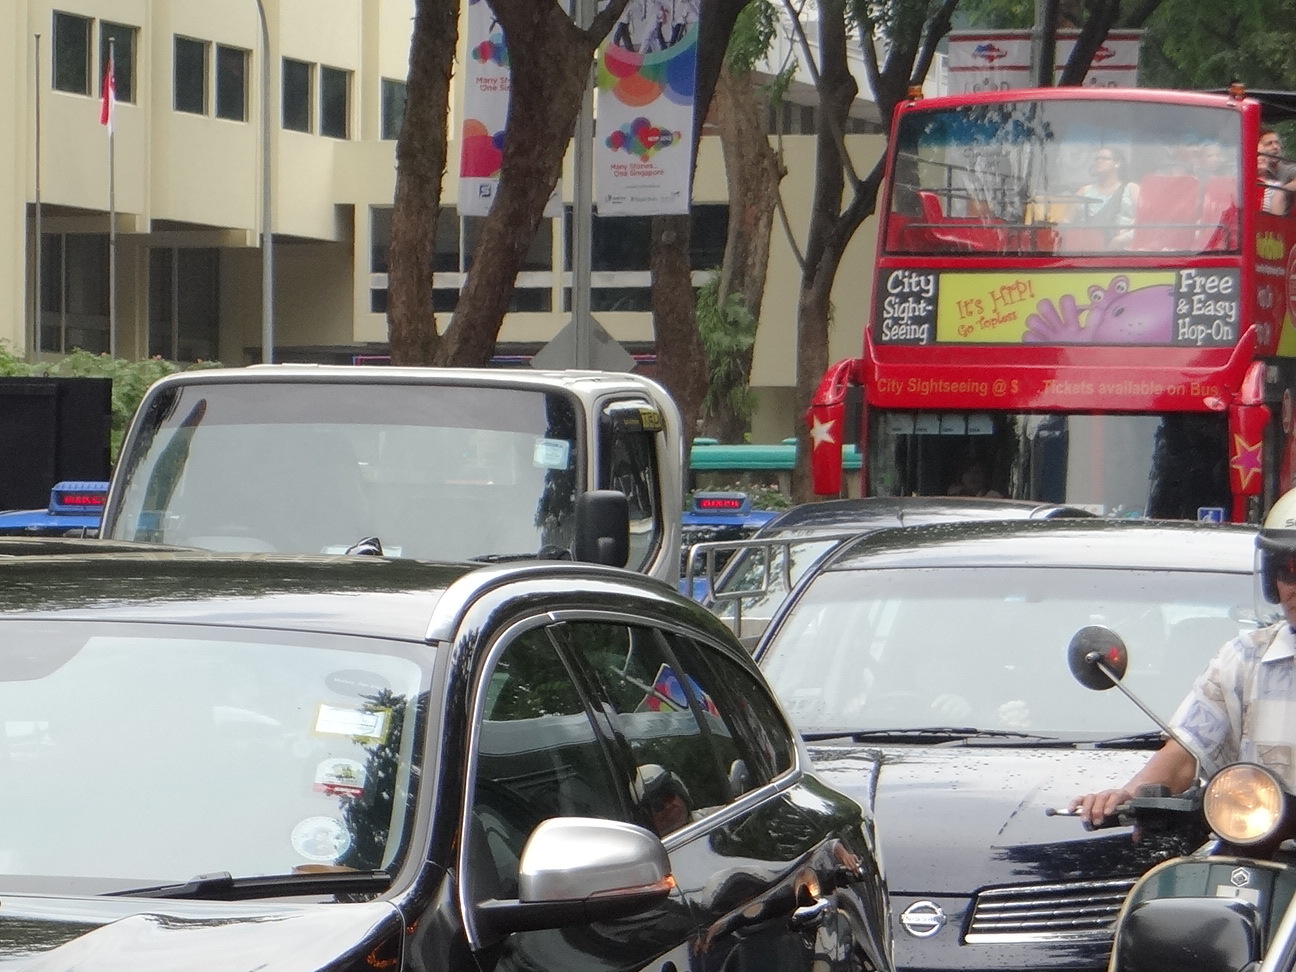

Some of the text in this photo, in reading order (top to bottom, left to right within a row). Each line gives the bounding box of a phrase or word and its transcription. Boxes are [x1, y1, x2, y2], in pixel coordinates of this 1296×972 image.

[887, 269, 934, 297] City
[1179, 269, 1233, 294] Free
[883, 296, 933, 324] Sight-
[956, 298, 984, 320] It's
[1176, 299, 1189, 314] &
[1192, 294, 1236, 322] Easy
[882, 319, 929, 345] Seeing
[957, 323, 974, 338] Go
[1178, 317, 1233, 346] Hop-On
[877, 378, 903, 395] City
[907, 377, 988, 396] Sightseeing
[992, 379, 1007, 397] @
[1043, 379, 1219, 396] Tickets available on Bus
